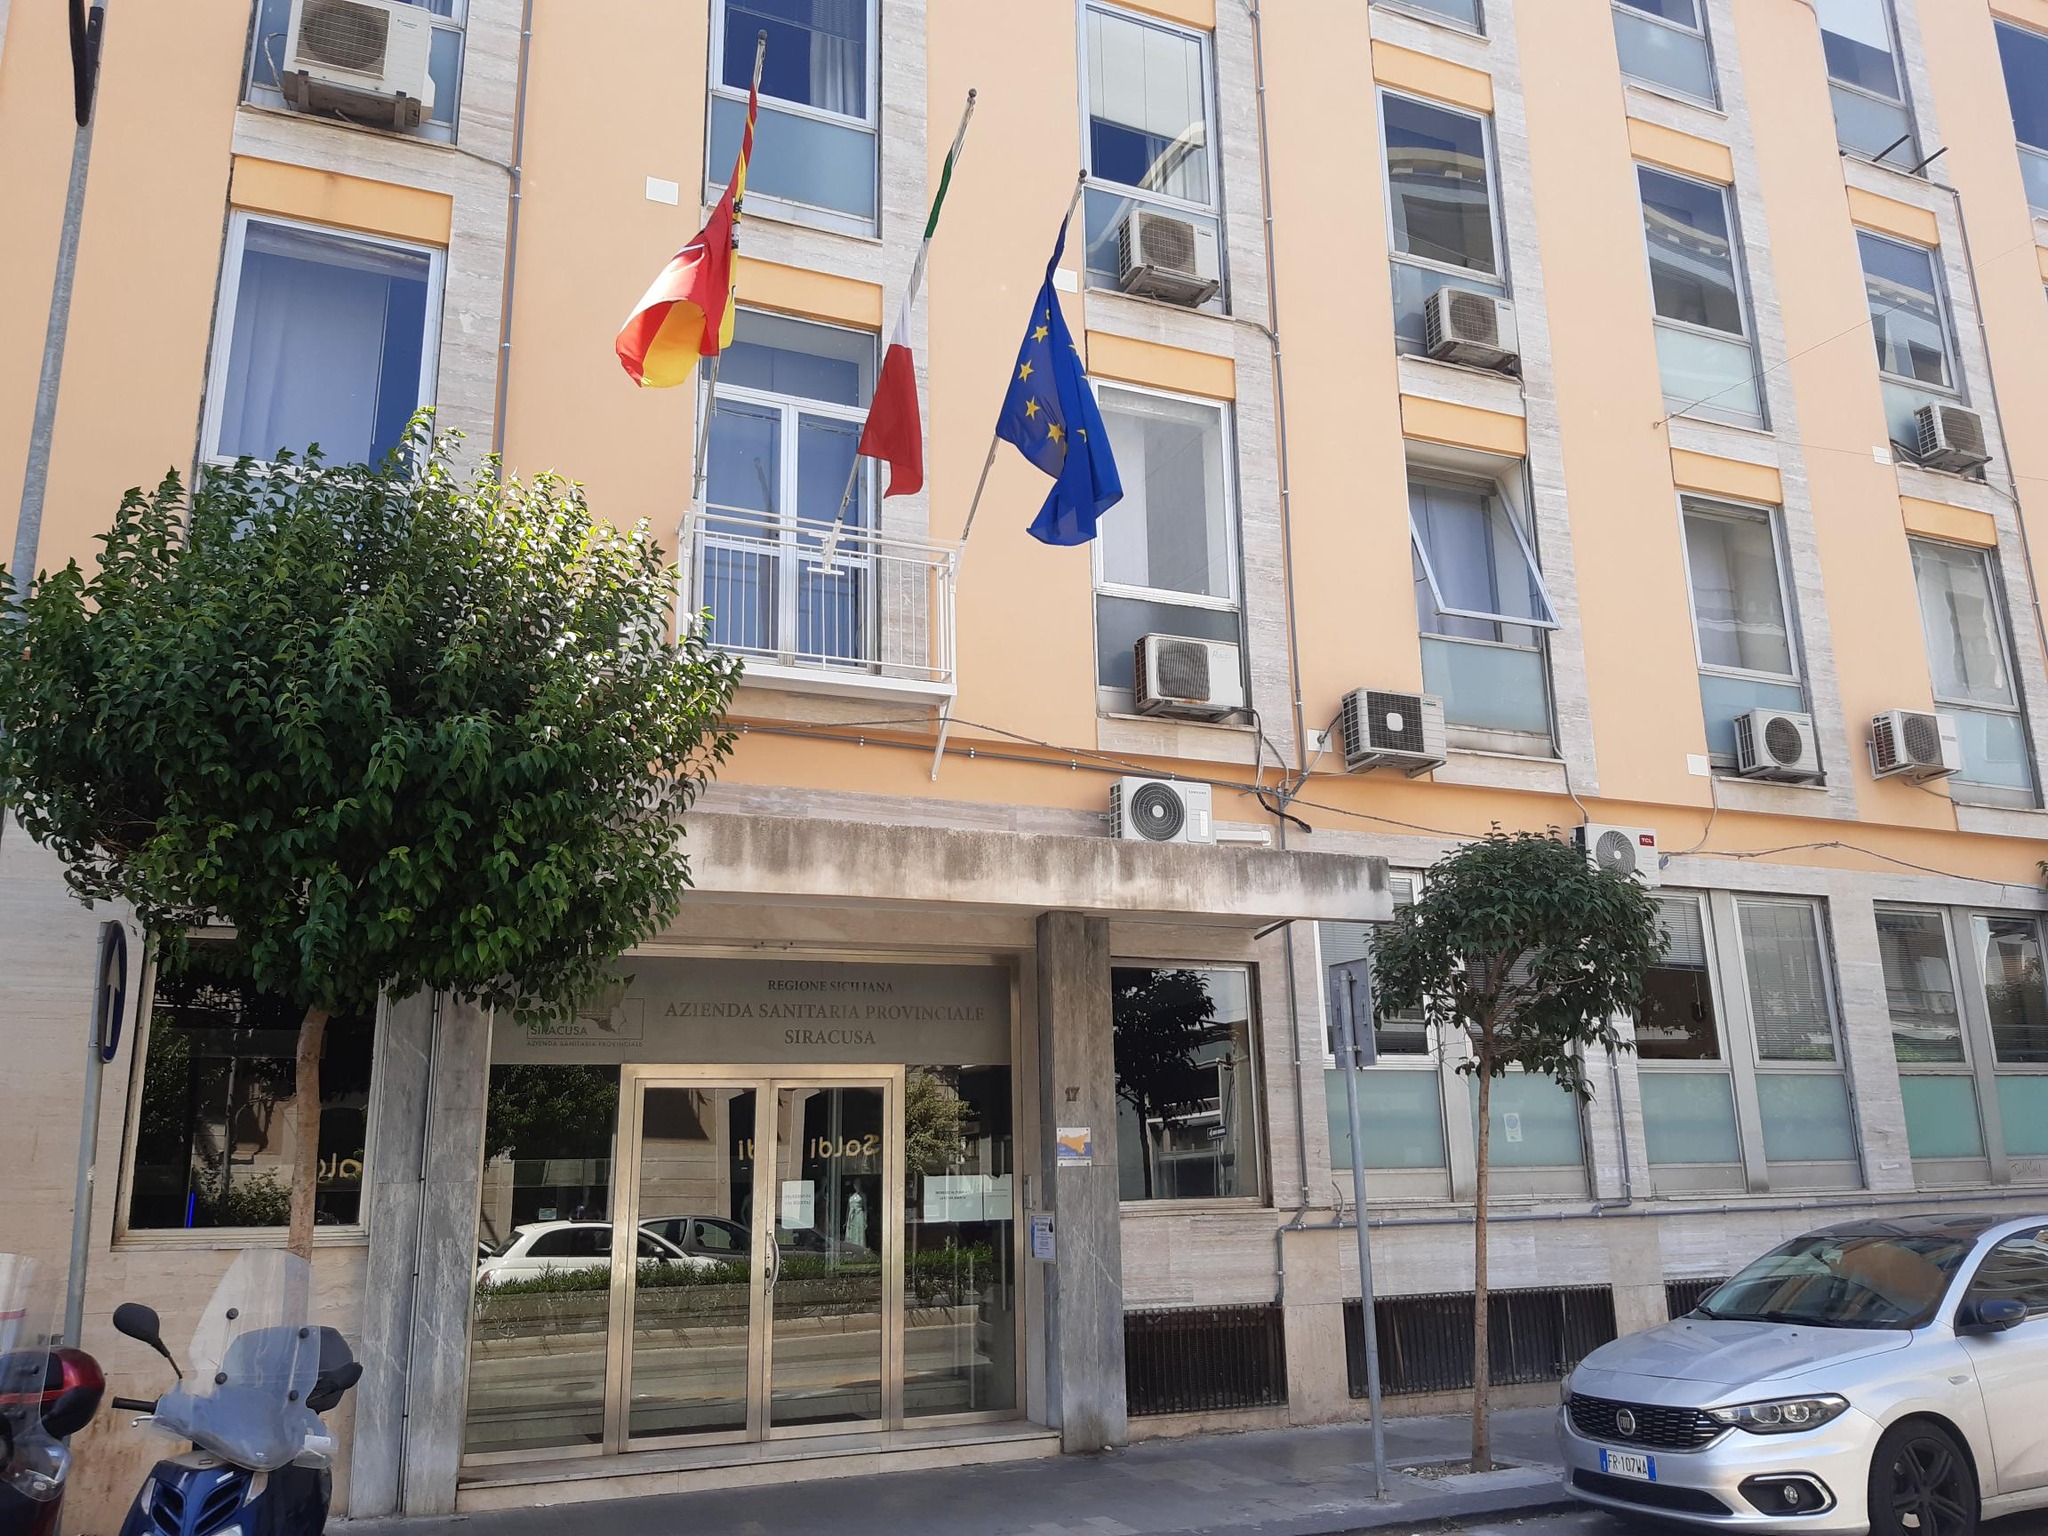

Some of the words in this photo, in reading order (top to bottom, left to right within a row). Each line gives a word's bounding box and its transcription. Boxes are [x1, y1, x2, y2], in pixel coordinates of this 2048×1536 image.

[768, 979, 827, 991] REGIONE
[830, 980, 894, 993] SICILIANA
[664, 1002, 754, 1018] AZIENDA
[758, 1003, 860, 1019] SANITARIA
[865, 1005, 985, 1021] PROVINCIALE
[784, 1029, 877, 1045] SIRACUSA
[1065, 1086, 1080, 1102] 17
